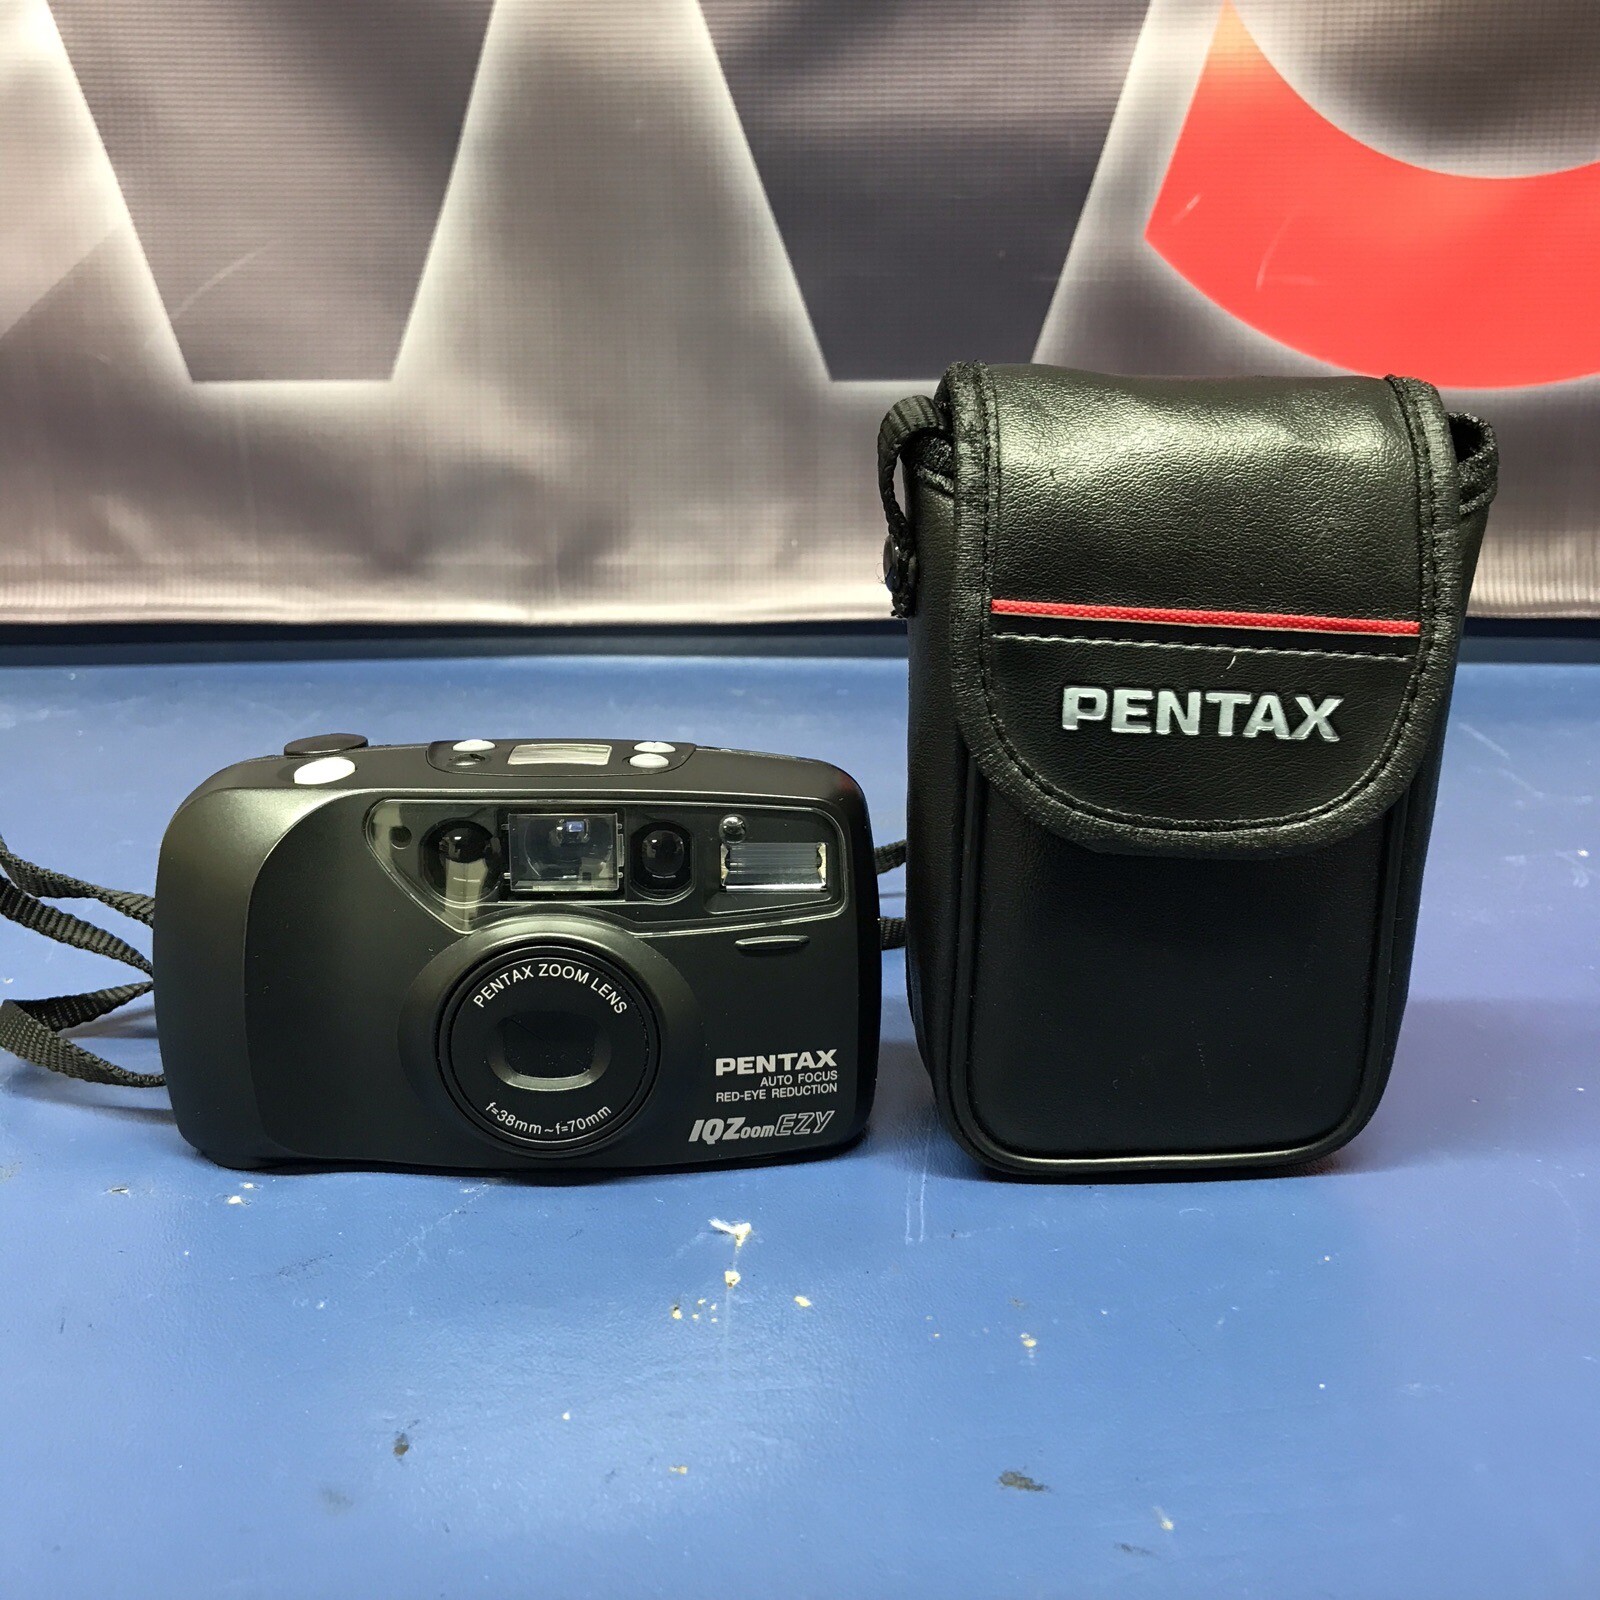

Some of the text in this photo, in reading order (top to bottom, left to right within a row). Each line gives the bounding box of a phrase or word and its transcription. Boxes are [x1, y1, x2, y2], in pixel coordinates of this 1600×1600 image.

[1062, 686, 1343, 742] PENTAX
[473, 963, 628, 1014] PENTAX ZOOM LENS
[715, 1049, 837, 1076] PENTAX
[715, 1082, 837, 1102] RED-EYE REDUCTION
[760, 1070, 838, 1087] AUTO FOCUS
